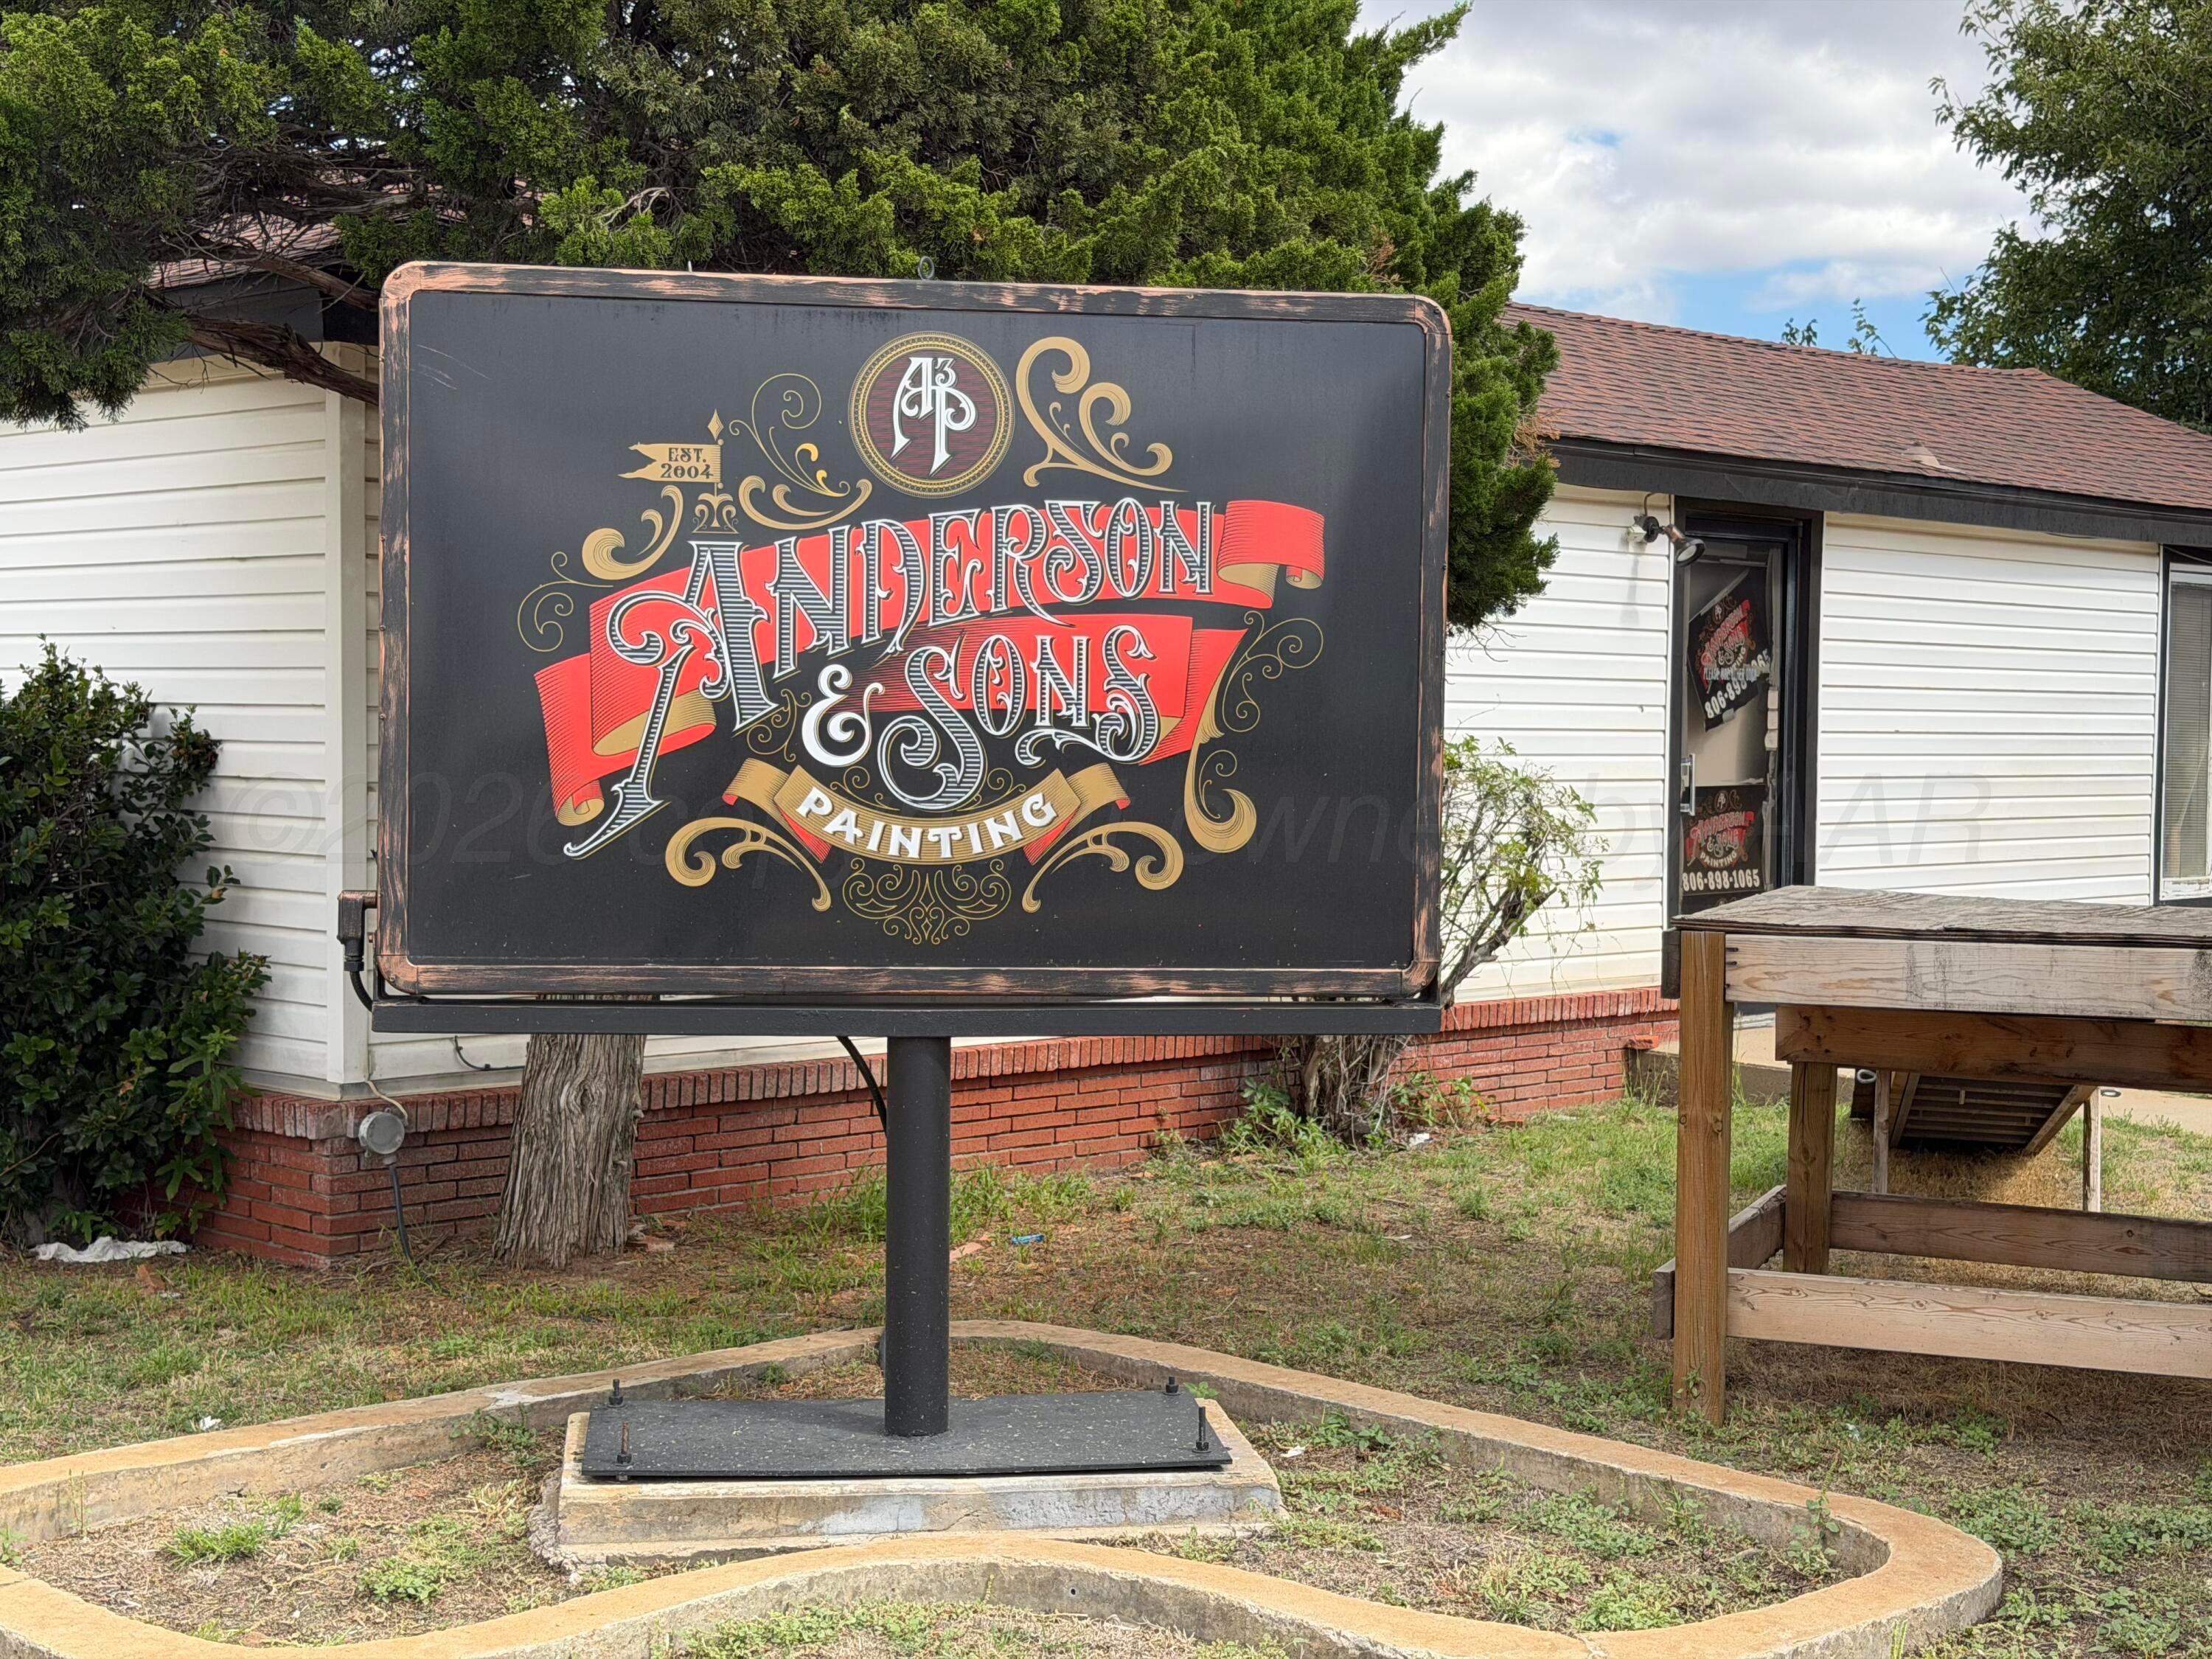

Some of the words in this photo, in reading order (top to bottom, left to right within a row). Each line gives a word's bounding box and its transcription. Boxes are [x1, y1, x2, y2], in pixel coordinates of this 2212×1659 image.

[660, 462, 714, 479] 2004
[668, 447, 707, 463] EST.
[563, 496, 1214, 858] ANDERSON
[801, 664, 883, 767] &
[877, 625, 1159, 810] SONS
[796, 787, 1059, 859] PAINTING
[1700, 851, 1737, 867] PAINTING
